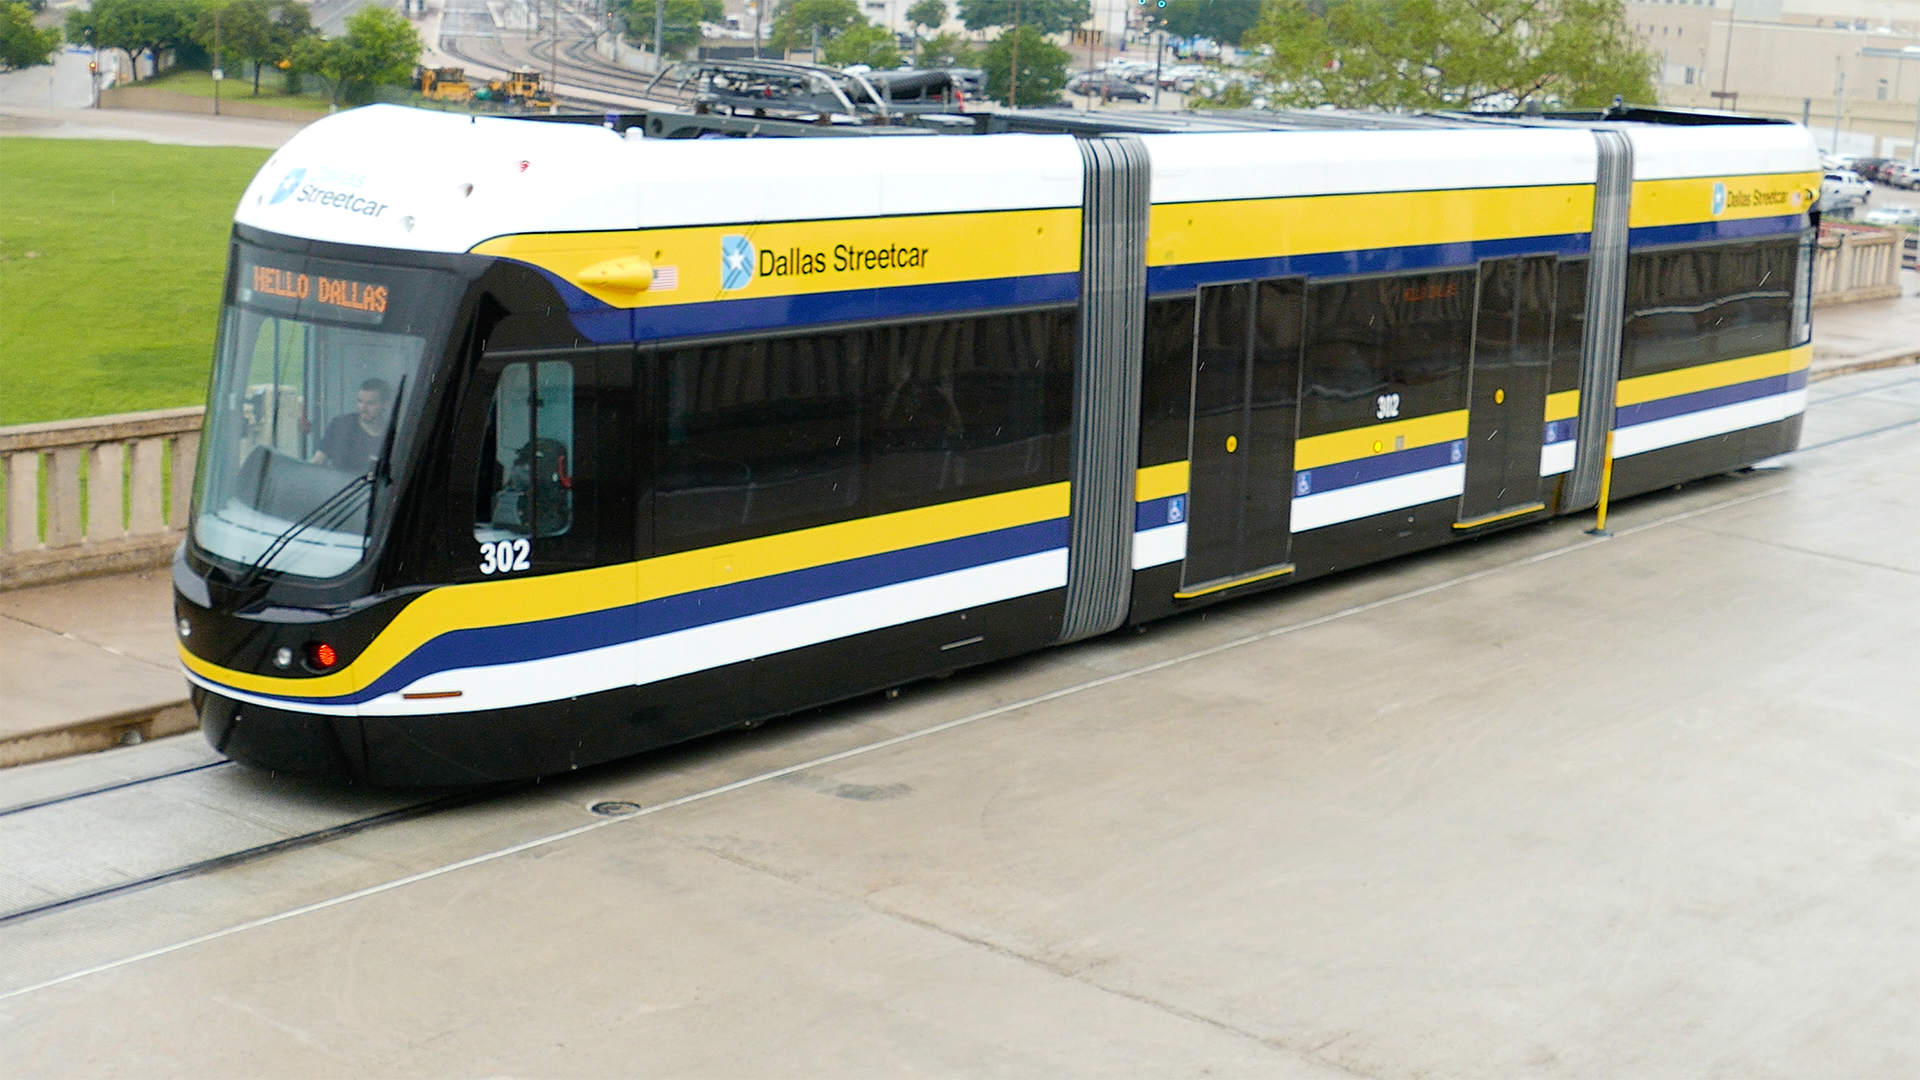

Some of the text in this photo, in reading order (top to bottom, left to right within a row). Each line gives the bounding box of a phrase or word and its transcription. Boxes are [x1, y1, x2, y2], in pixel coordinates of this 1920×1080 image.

[297, 184, 389, 218] Streetcar
[759, 243, 929, 277] Dallas Streetcar
[253, 265, 388, 313] HELLO DALLAS
[1376, 393, 1400, 420] 302
[479, 538, 531, 575] 302
